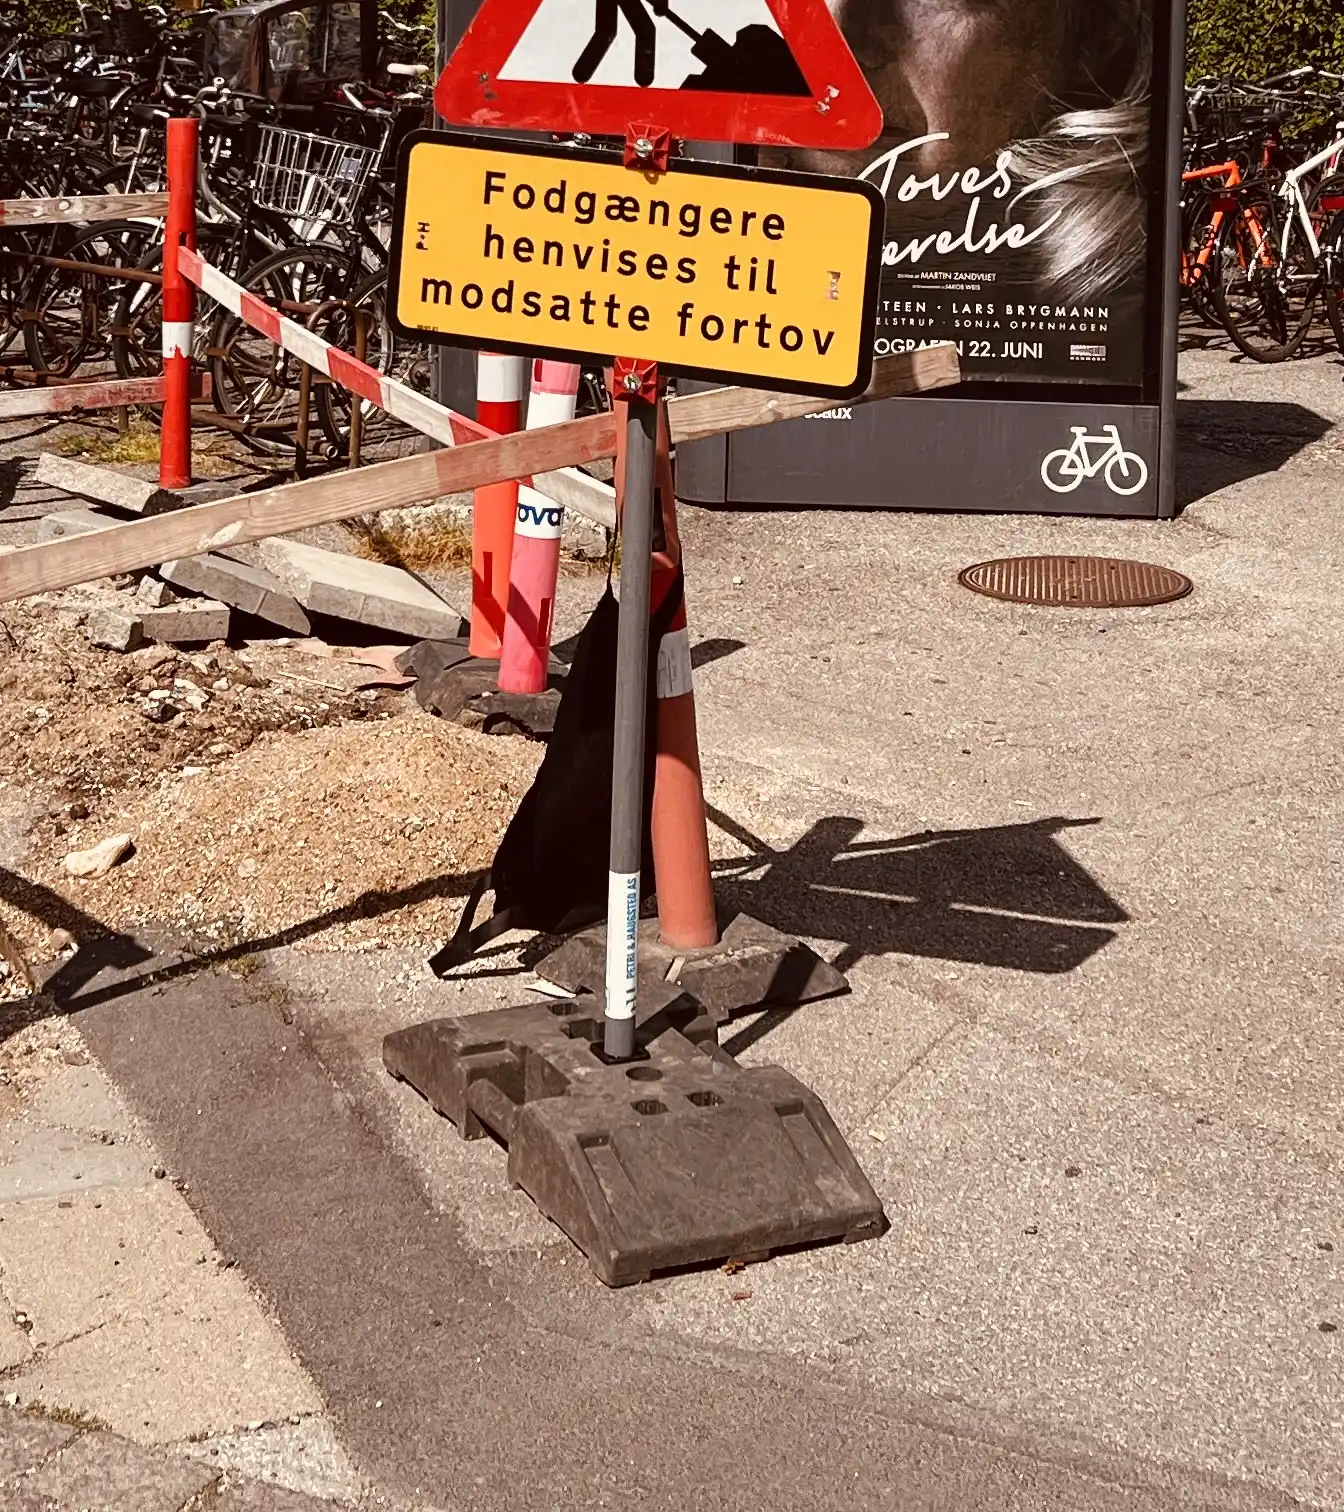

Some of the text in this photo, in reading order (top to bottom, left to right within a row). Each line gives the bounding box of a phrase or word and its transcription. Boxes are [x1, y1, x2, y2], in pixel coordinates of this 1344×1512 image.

[482, 170, 786, 241] Fodgængere
[483, 223, 698, 284] henvises
[723, 254, 778, 295] til
[920, 271, 952, 280] MARTIN
[421, 277, 836, 356] modsatte fortov
[876, 300, 1109, 319] TEEN LARS BRYGMANN
[954, 319, 1000, 329] SONJA
[1009, 320, 1108, 332] OPPENHAGEN
[968, 341, 996, 359] 22.
[1000, 341, 1044, 359] JUNI
[627, 877, 637, 890] AS
[626, 953, 636, 980] PETRI
